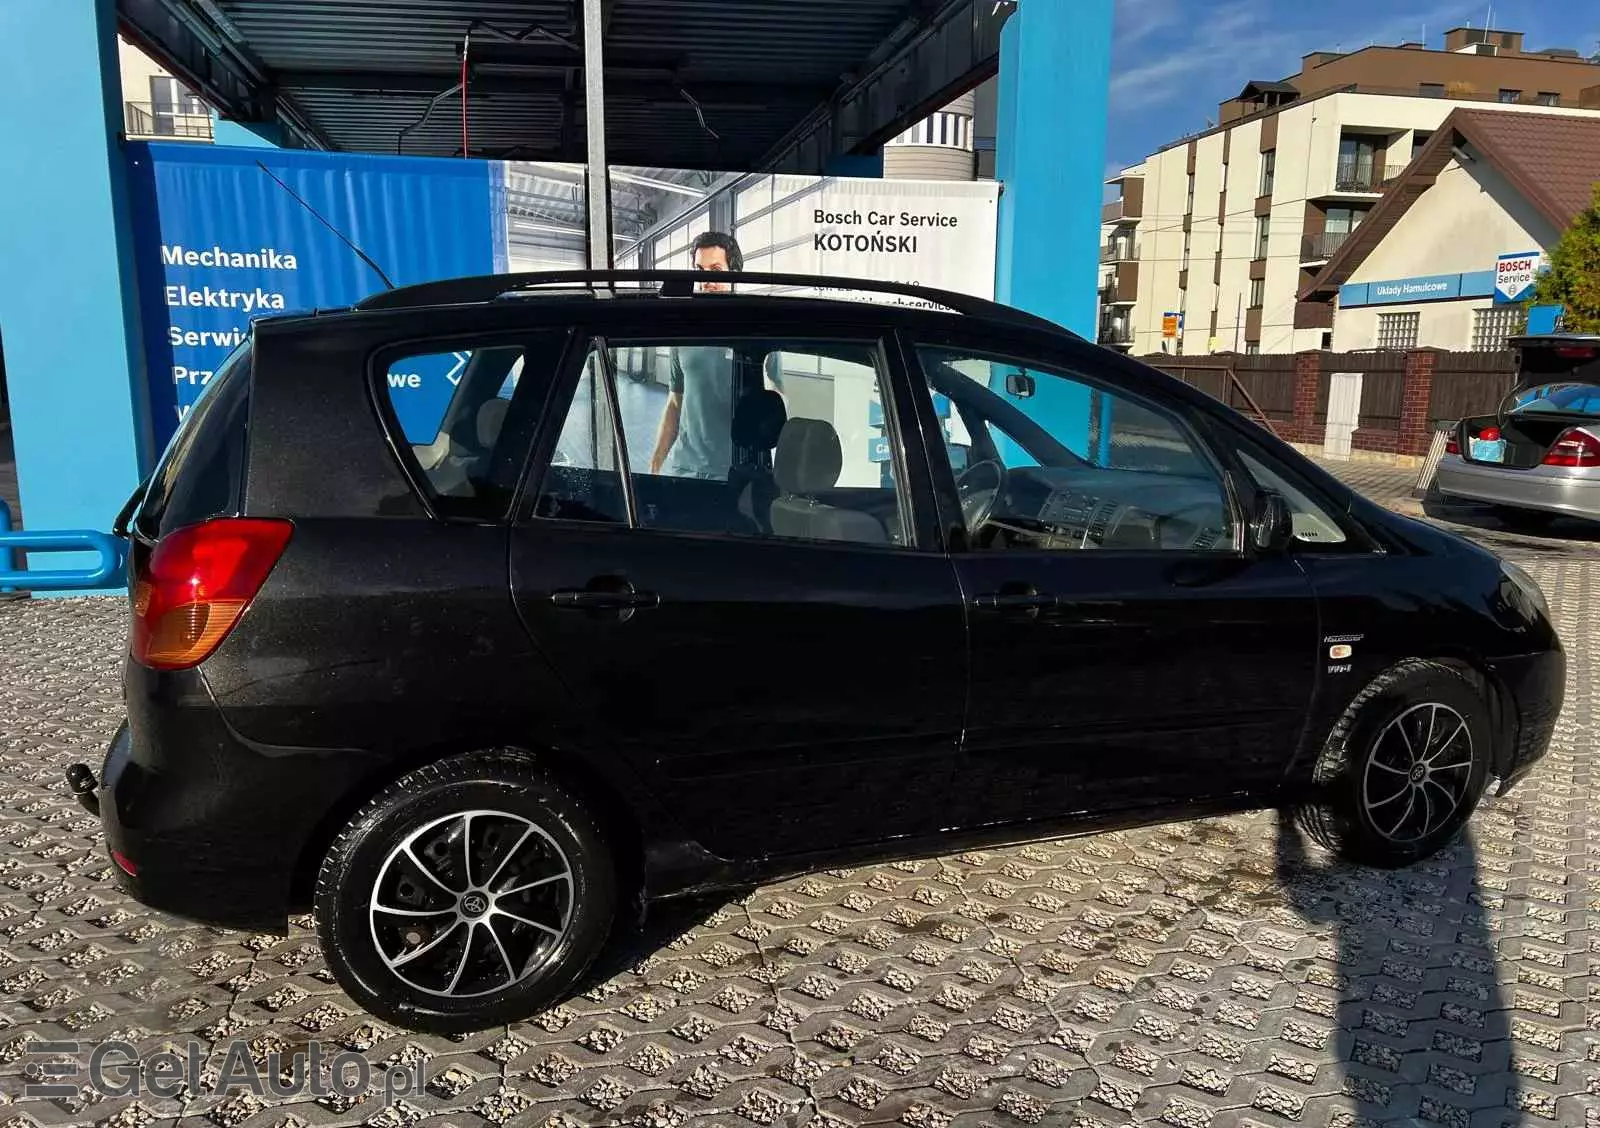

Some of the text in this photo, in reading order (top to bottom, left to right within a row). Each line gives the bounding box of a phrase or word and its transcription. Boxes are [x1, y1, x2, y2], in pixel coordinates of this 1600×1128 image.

[814, 209, 958, 228] Bosch Car Service
[813, 230, 917, 253] KOTOŃSKI
[161, 245, 298, 271] Mechanika
[1499, 260, 1531, 272] BOSCH
[1403, 282, 1448, 294] Hamulcowe
[1498, 274, 1530, 284] Service
[164, 286, 285, 312] Elektryka
[168, 326, 247, 346] Serwi
[172, 366, 421, 388] Prz we
